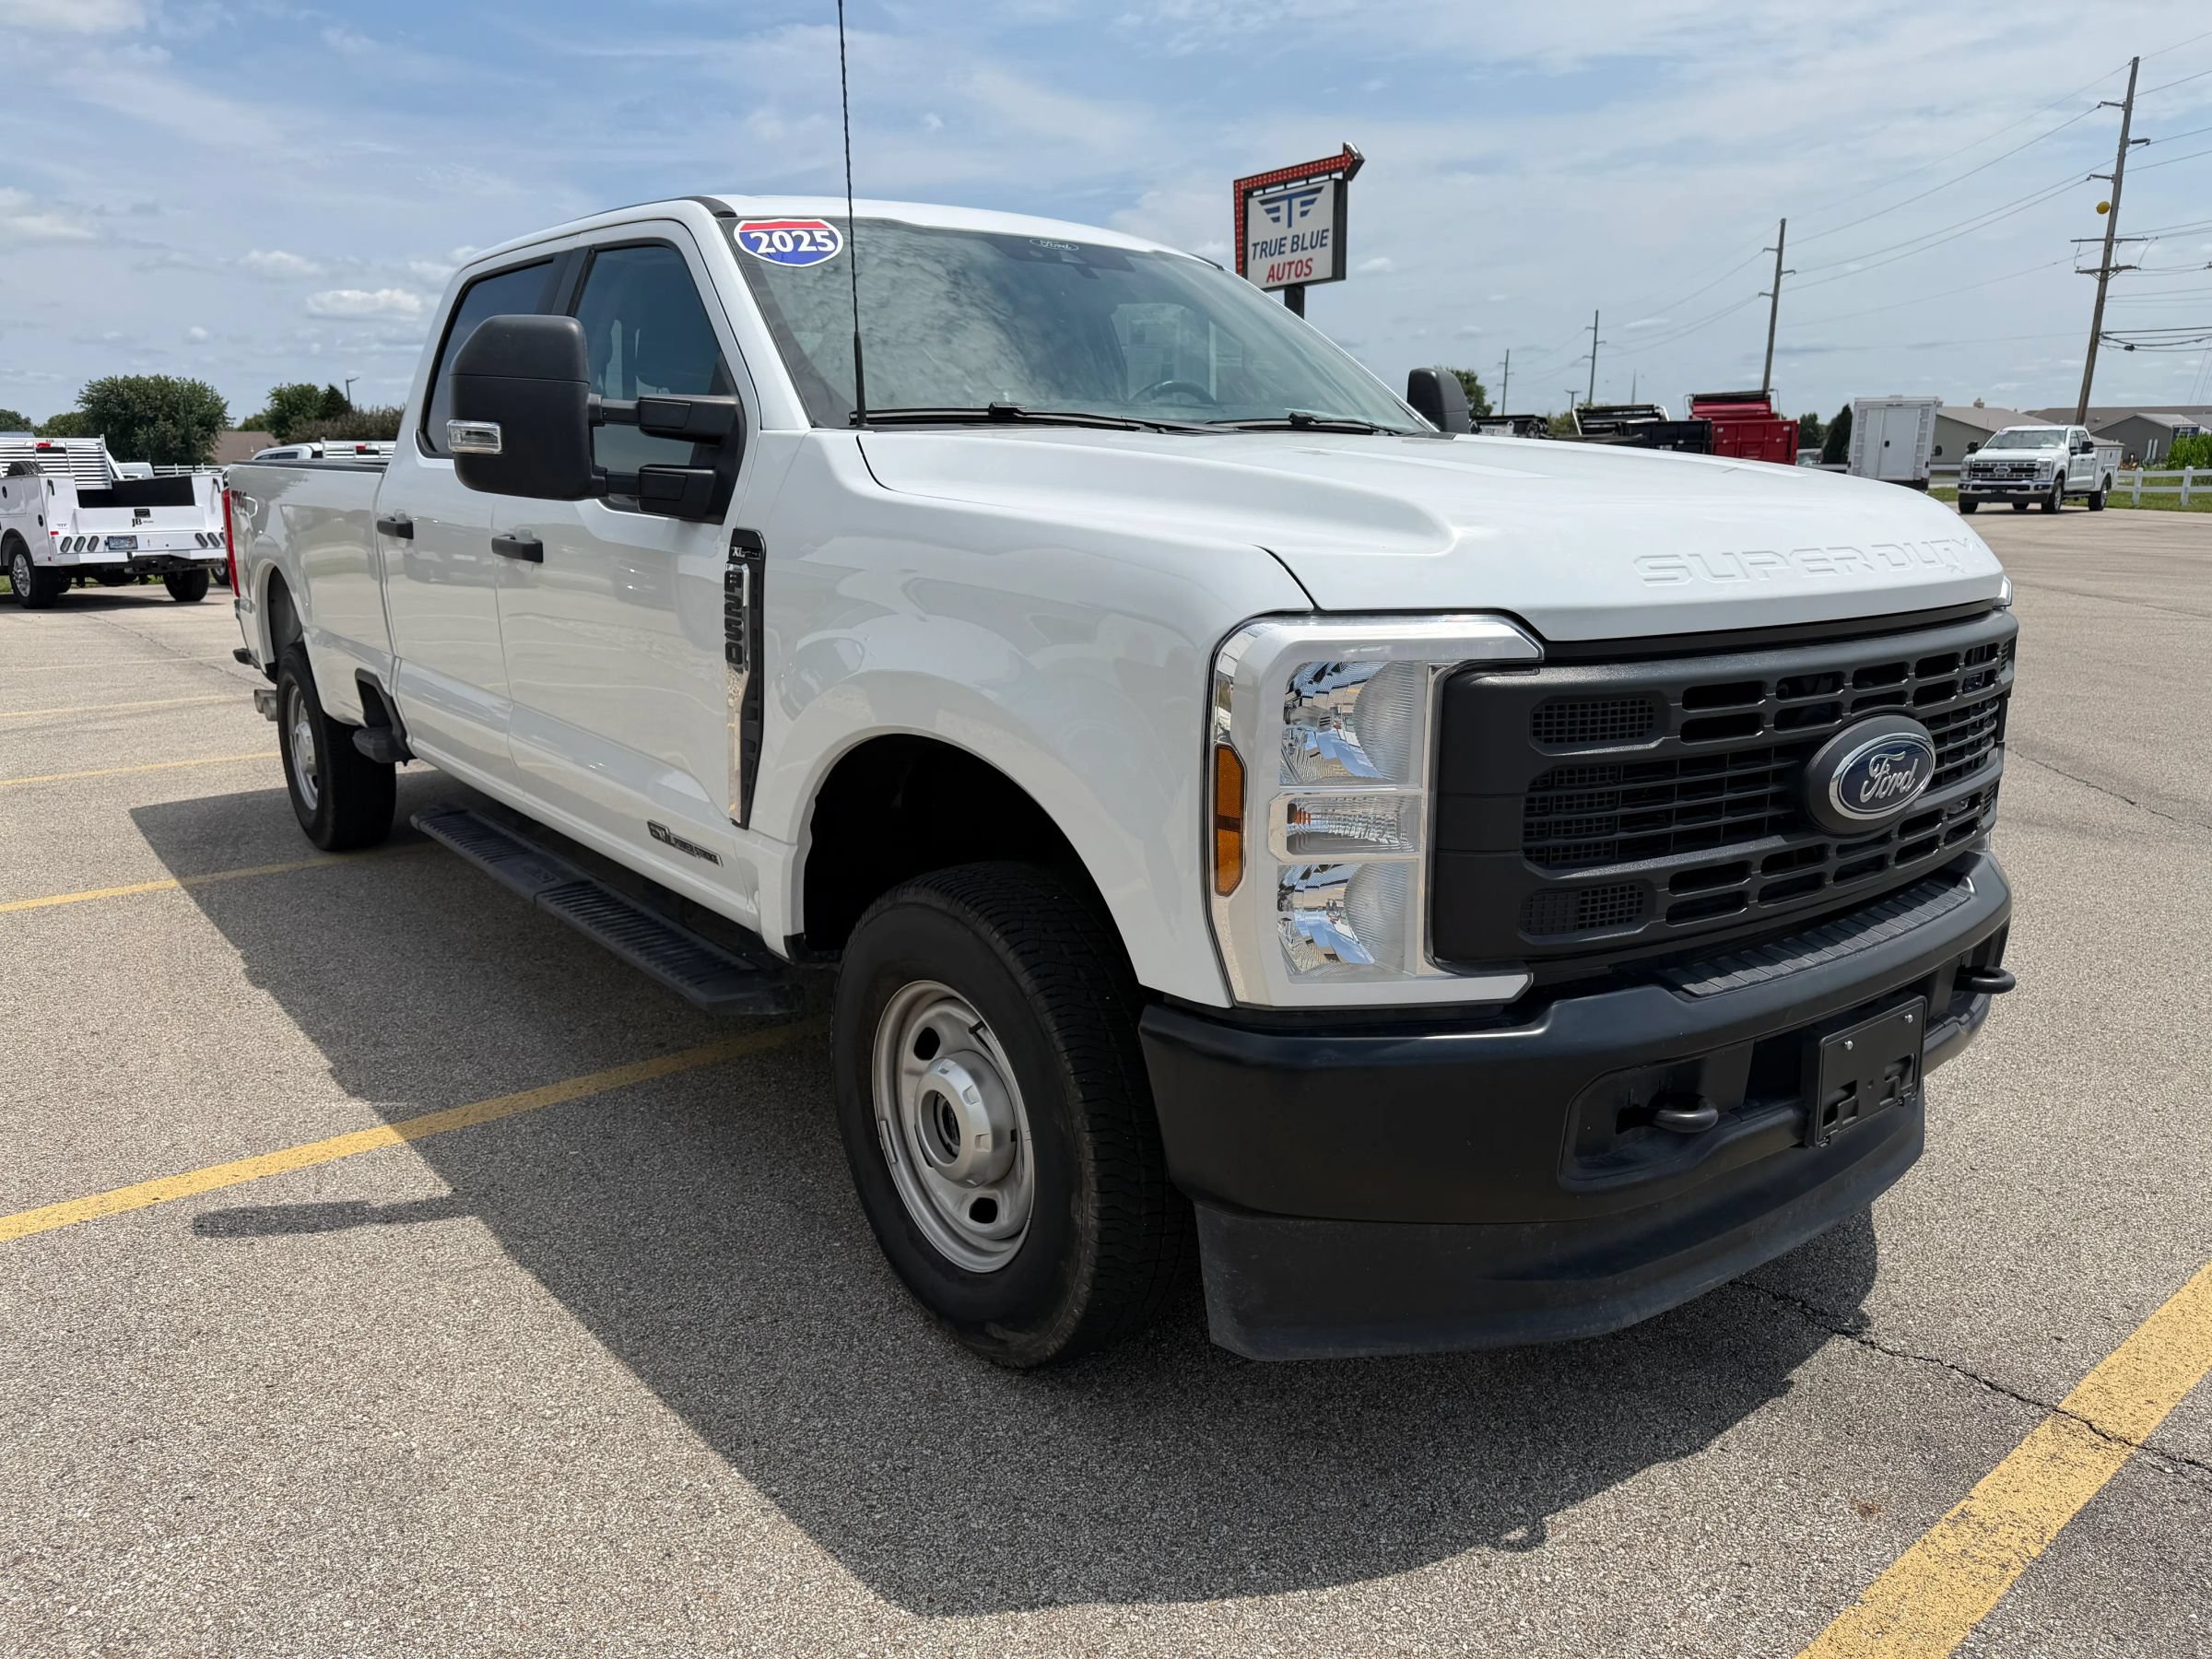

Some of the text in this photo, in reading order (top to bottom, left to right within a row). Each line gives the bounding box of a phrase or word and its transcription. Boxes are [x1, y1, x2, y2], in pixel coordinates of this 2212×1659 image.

[749, 230, 836, 253] 2025
[1252, 229, 1329, 261] TRUE BLUE
[1266, 257, 1313, 283] AUTOS
[132, 518, 143, 527] JB
[733, 547, 746, 558] XL
[1860, 750, 1919, 803] Ford
